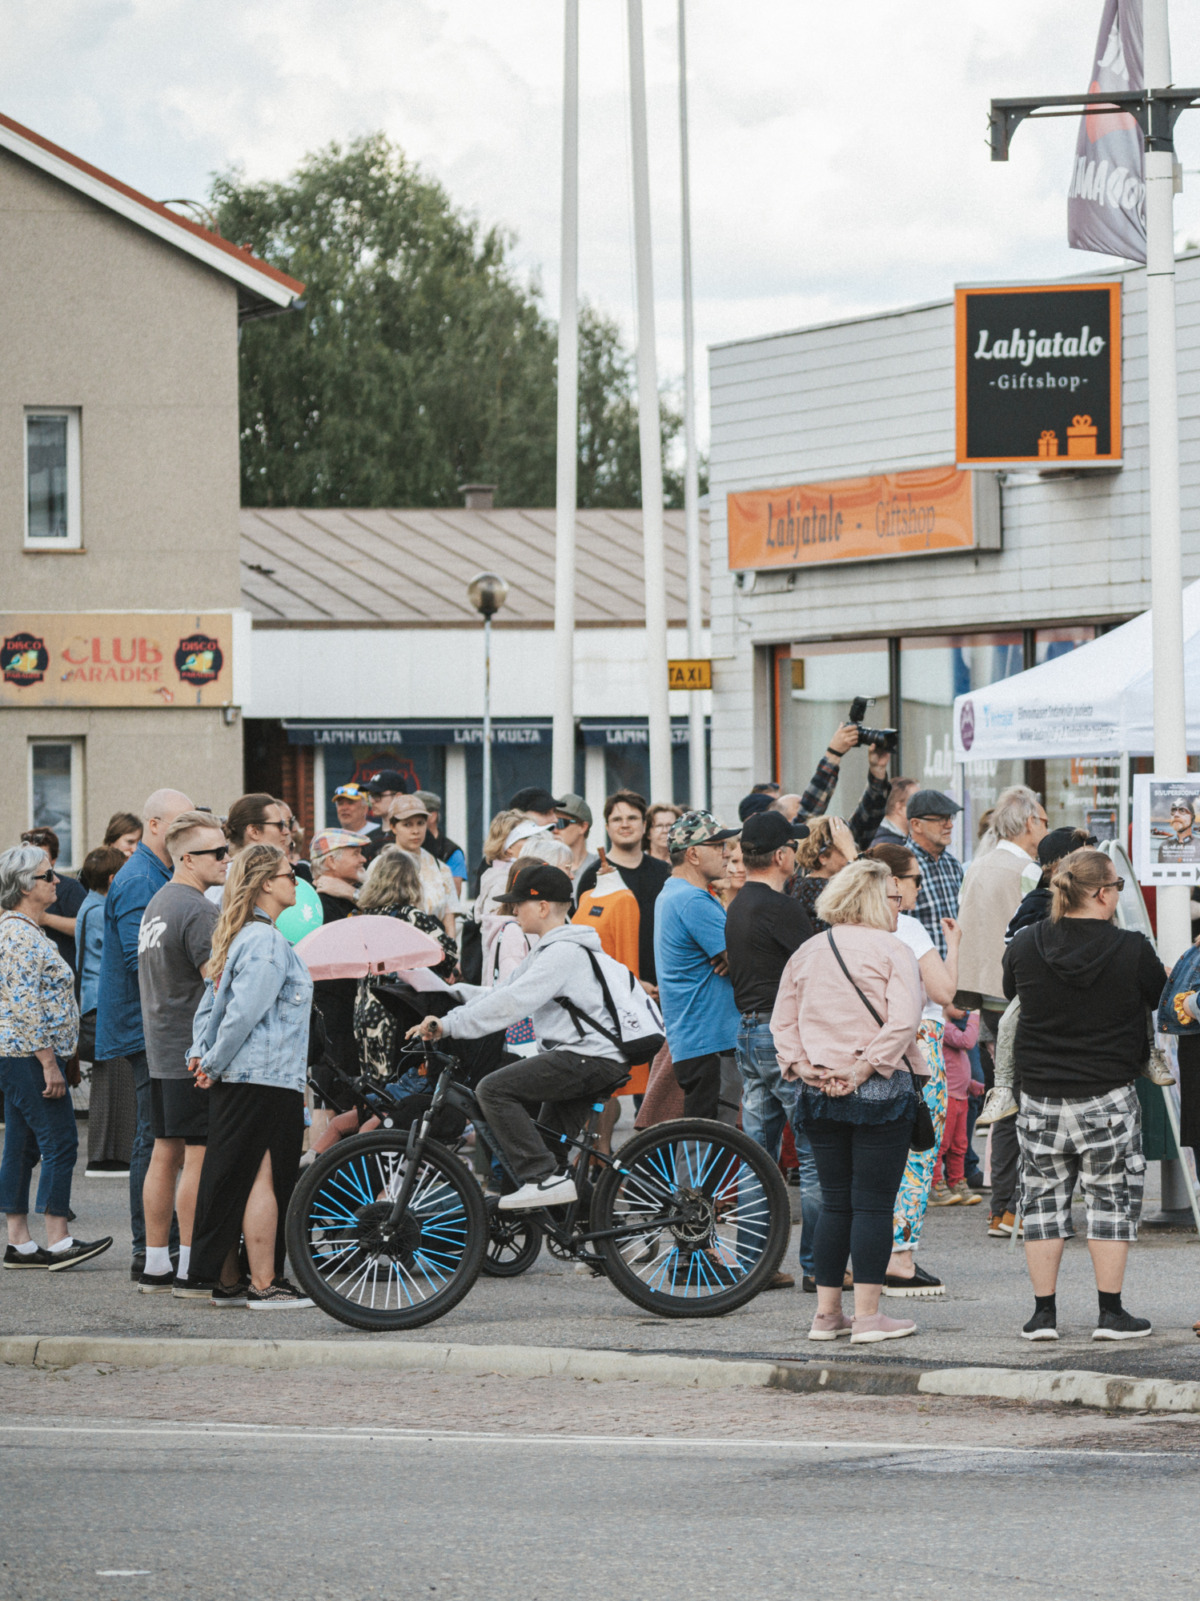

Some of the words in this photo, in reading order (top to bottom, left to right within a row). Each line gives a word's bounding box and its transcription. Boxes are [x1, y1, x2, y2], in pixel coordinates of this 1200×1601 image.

[973, 325, 1107, 368] Lahjatalo
[989, 372, 1089, 393] -Giftshop-
[875, 493, 936, 547] Giftshop
[7, 641, 42, 650] DISCO
[61, 637, 163, 664] CLUB
[181, 641, 217, 651] DISCO
[71, 666, 163, 682] ARADISE
[668, 667, 703, 682] TAXI
[313, 730, 355, 744] LAPIN
[357, 730, 402, 744] KULTA
[497, 729, 541, 744] KULTA
[605, 730, 648, 743] LAPIN
